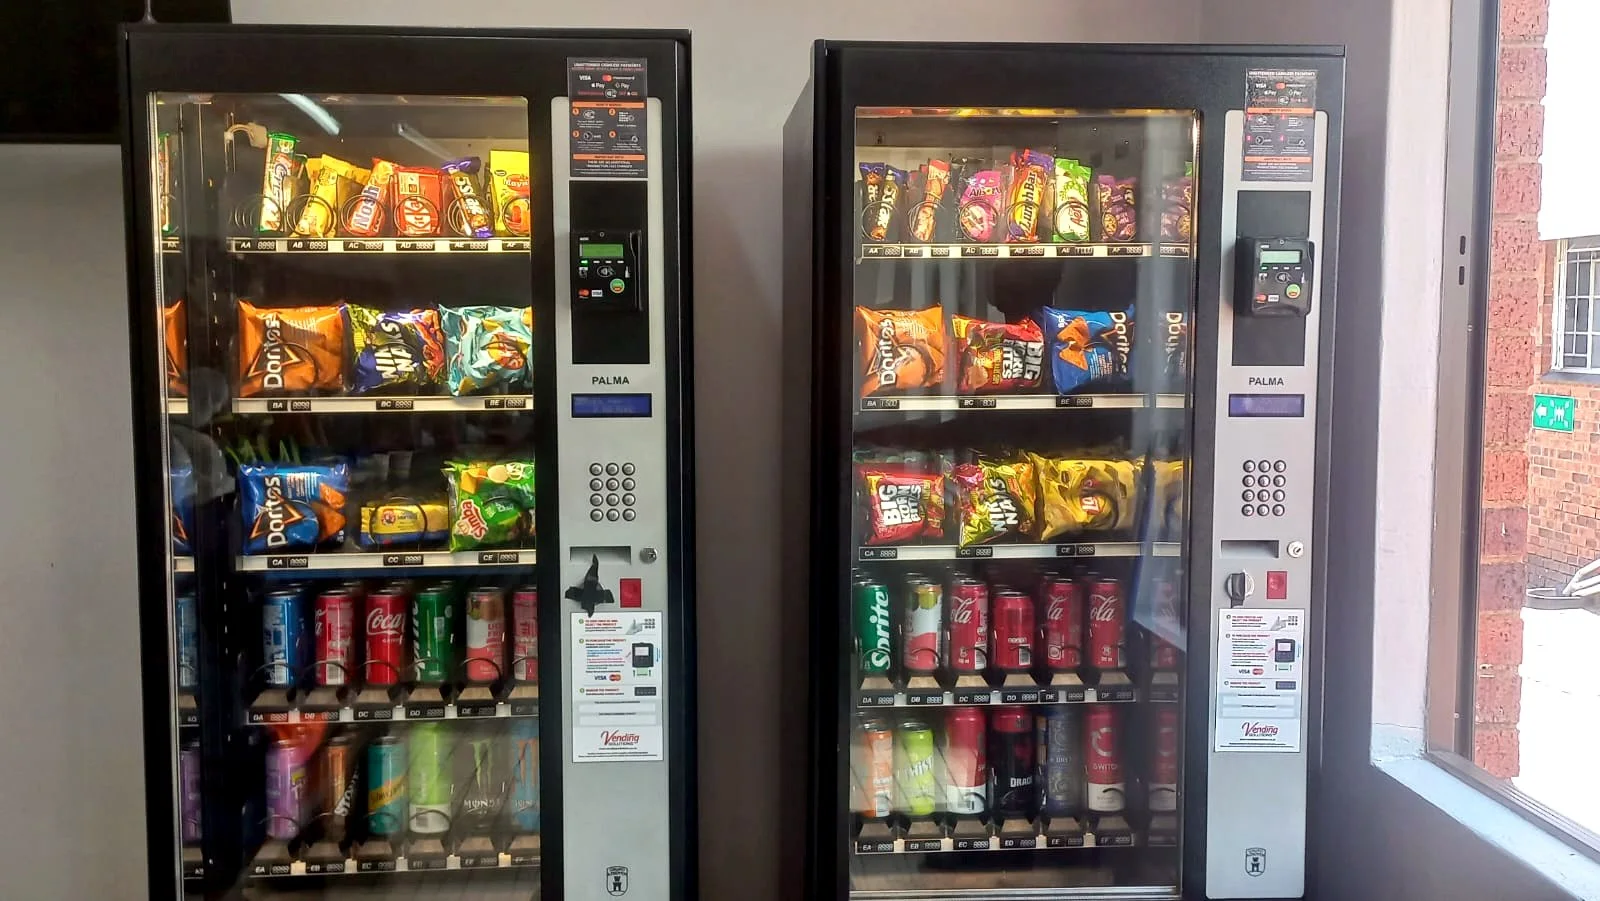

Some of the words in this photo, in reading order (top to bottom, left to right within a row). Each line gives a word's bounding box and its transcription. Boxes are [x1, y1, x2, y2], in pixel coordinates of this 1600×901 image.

[1024, 172, 1036, 190] Bar
[352, 185, 382, 230] Nosh
[1020, 191, 1034, 232] Lunch
[263, 313, 284, 389] Doritos
[375, 345, 399, 379] NIK
[880, 318, 897, 386] Doritos
[1024, 341, 1044, 380] BIG
[592, 376, 630, 384] PALMA
[264, 476, 288, 548] Doritos
[462, 501, 489, 538] Simba
[878, 484, 902, 526] BIG
[984, 499, 1008, 532] NIK
[366, 608, 402, 634] Coca
[870, 590, 891, 670] Sprite
[600, 730, 640, 746] Vending
[1242, 722, 1278, 736] Vending
